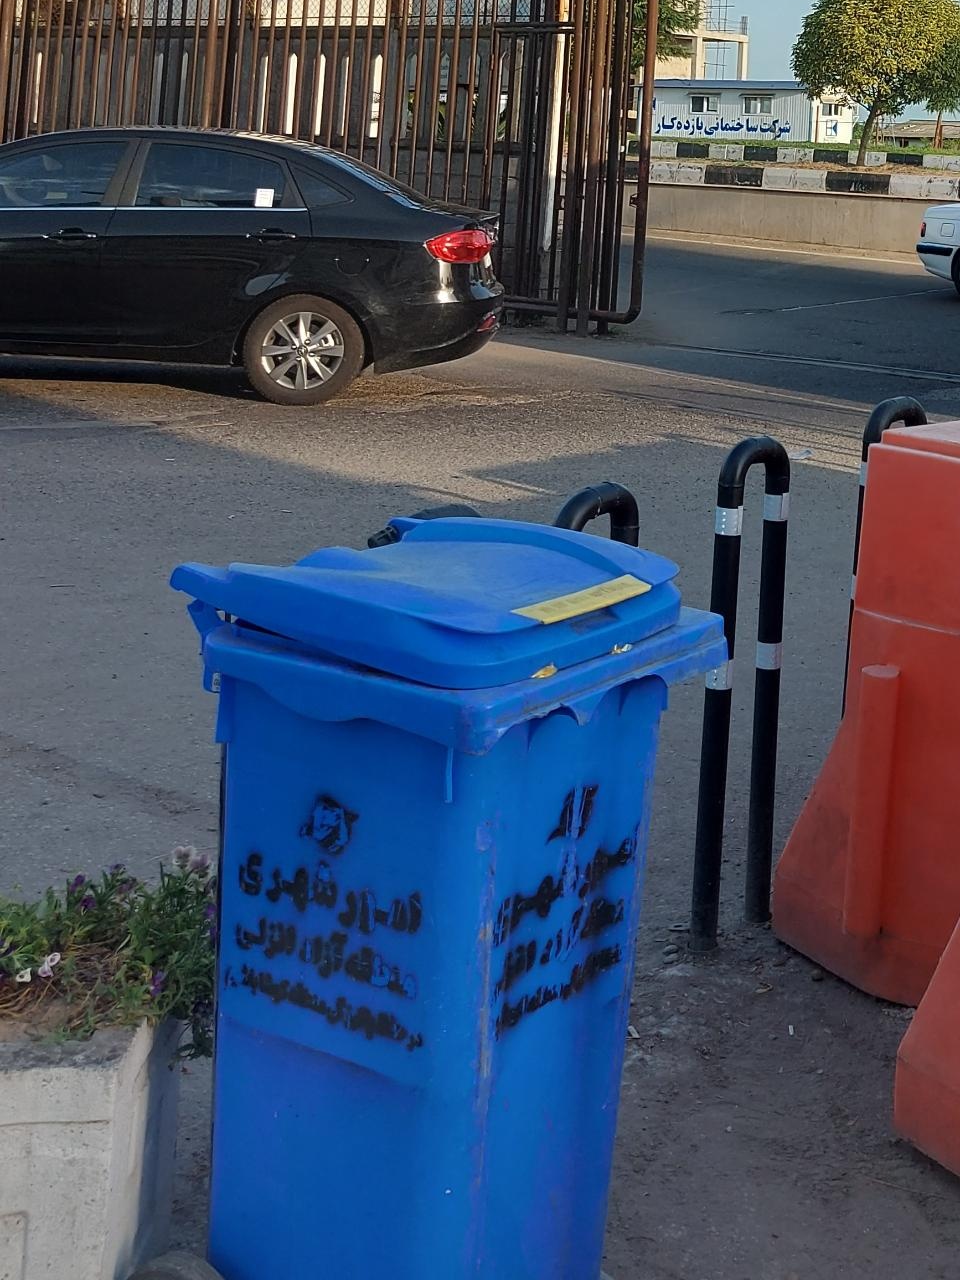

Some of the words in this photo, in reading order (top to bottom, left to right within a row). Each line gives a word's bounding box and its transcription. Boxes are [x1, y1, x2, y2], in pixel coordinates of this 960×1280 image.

[704, 117, 758, 136] ساختمانی
[759, 118, 792, 140] شرکت
[239, 853, 337, 912] شهری
